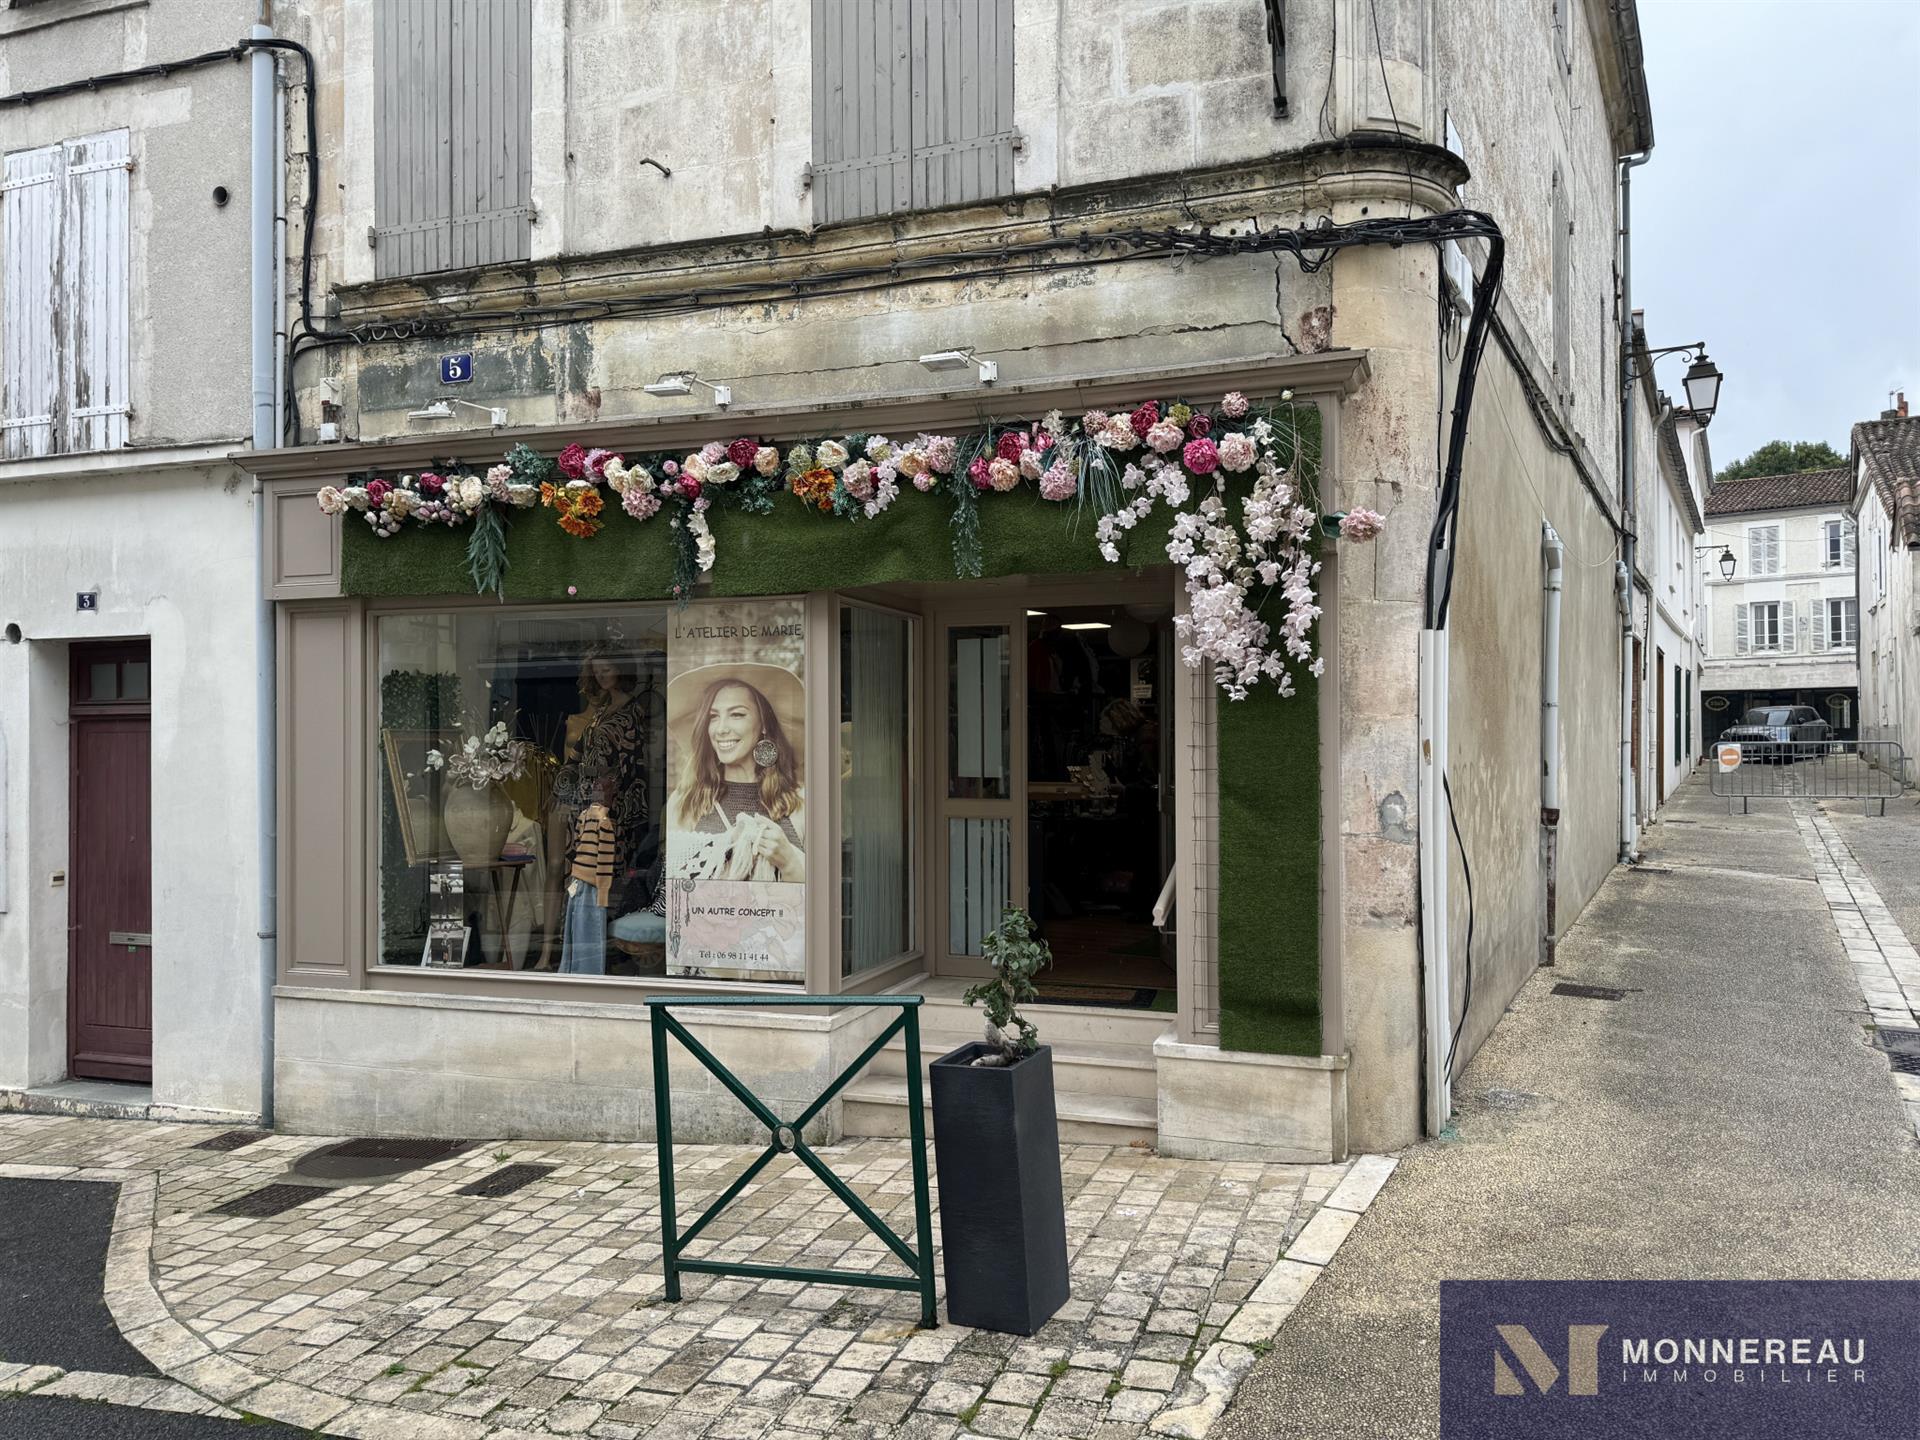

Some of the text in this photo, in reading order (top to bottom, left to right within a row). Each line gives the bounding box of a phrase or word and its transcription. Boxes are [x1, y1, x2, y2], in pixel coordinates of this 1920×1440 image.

[449, 357, 461, 379] 5
[83, 595, 90, 608] 3
[675, 623, 802, 639] L'ATELIER DE MARIE
[691, 906, 705, 915] UN
[707, 907, 735, 916] AUTRE
[738, 908, 776, 917] CONCEPT
[716, 951, 726, 959] 06
[728, 952, 737, 960] 98
[749, 953, 758, 961] 41
